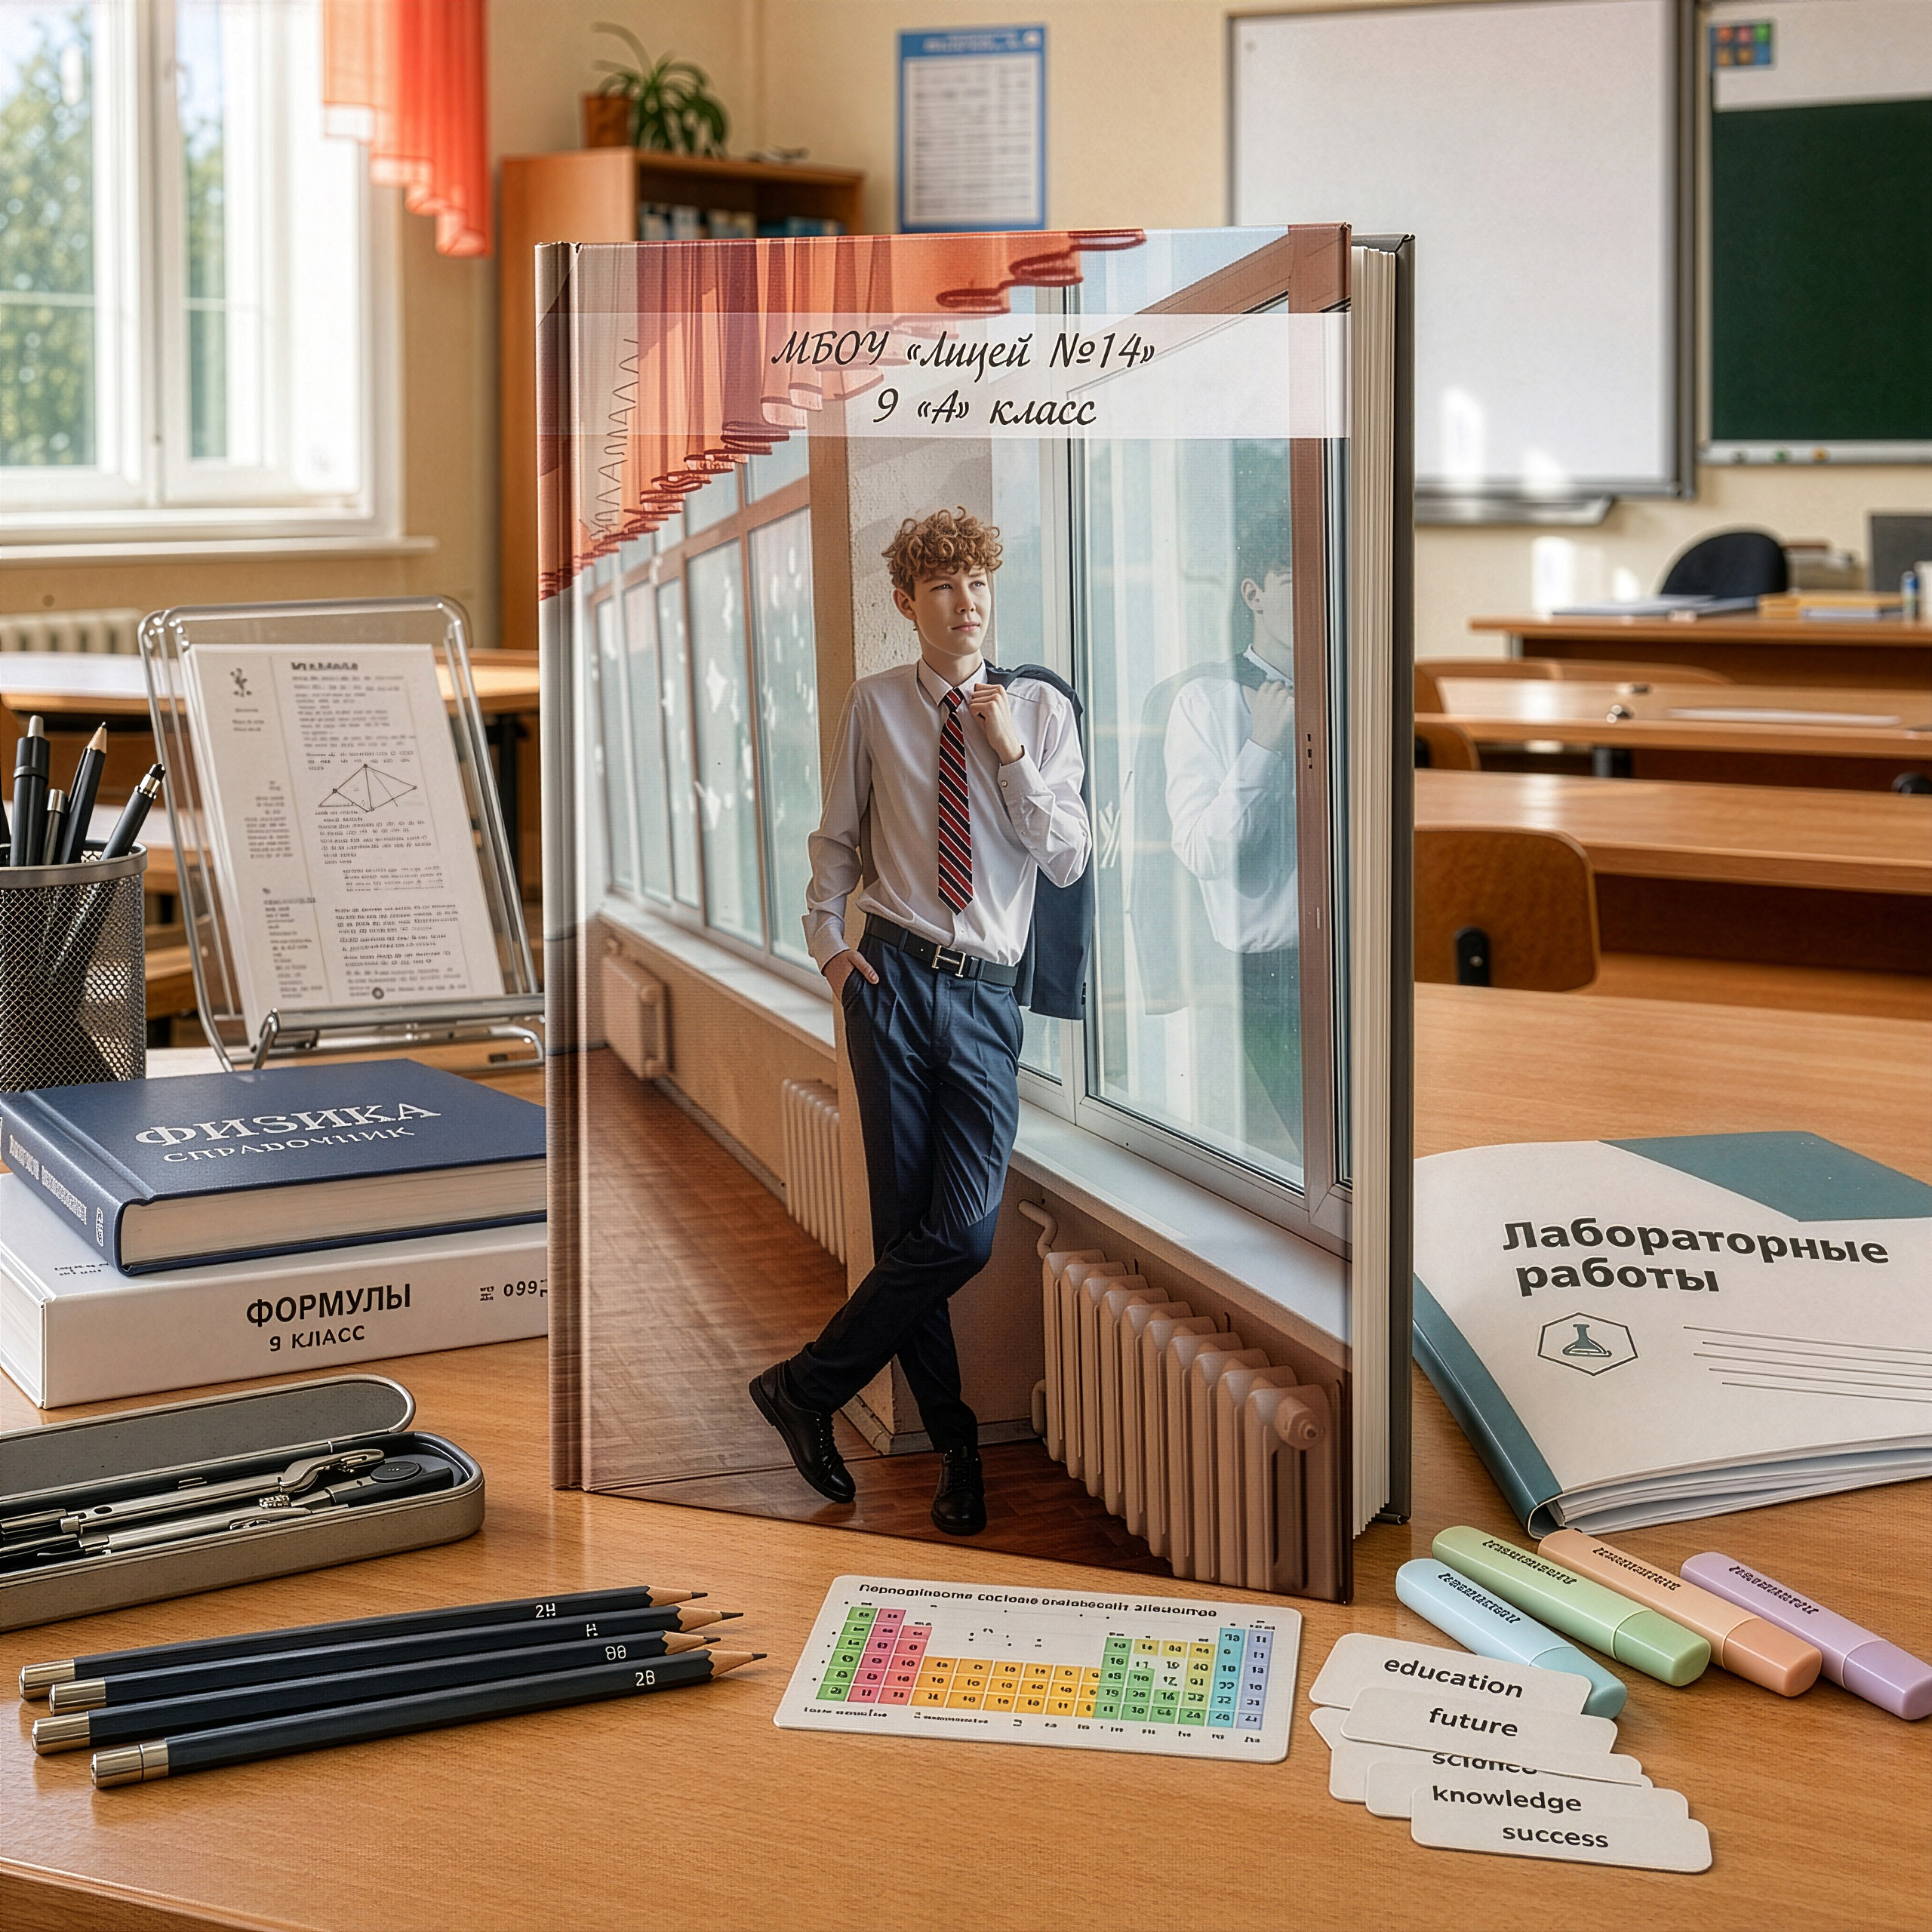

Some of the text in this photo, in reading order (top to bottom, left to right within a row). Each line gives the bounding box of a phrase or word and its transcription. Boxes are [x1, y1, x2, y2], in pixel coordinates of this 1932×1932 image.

[771, 329, 1155, 383] МБОУ «Лицей №14»
[872, 388, 1097, 426] 9 «А» класс
[1503, 1217, 1889, 1265] Лабораторные
[1516, 1257, 1721, 1297] работы
[246, 1283, 411, 1327] ФОРМУЛЫ
[269, 1324, 365, 1352] 9 КЛАСС
[1384, 1657, 1524, 1699] education
[1429, 1707, 1518, 1737] future
[1432, 1785, 1583, 1814] knowledge
[1502, 1823, 1610, 1850] success
